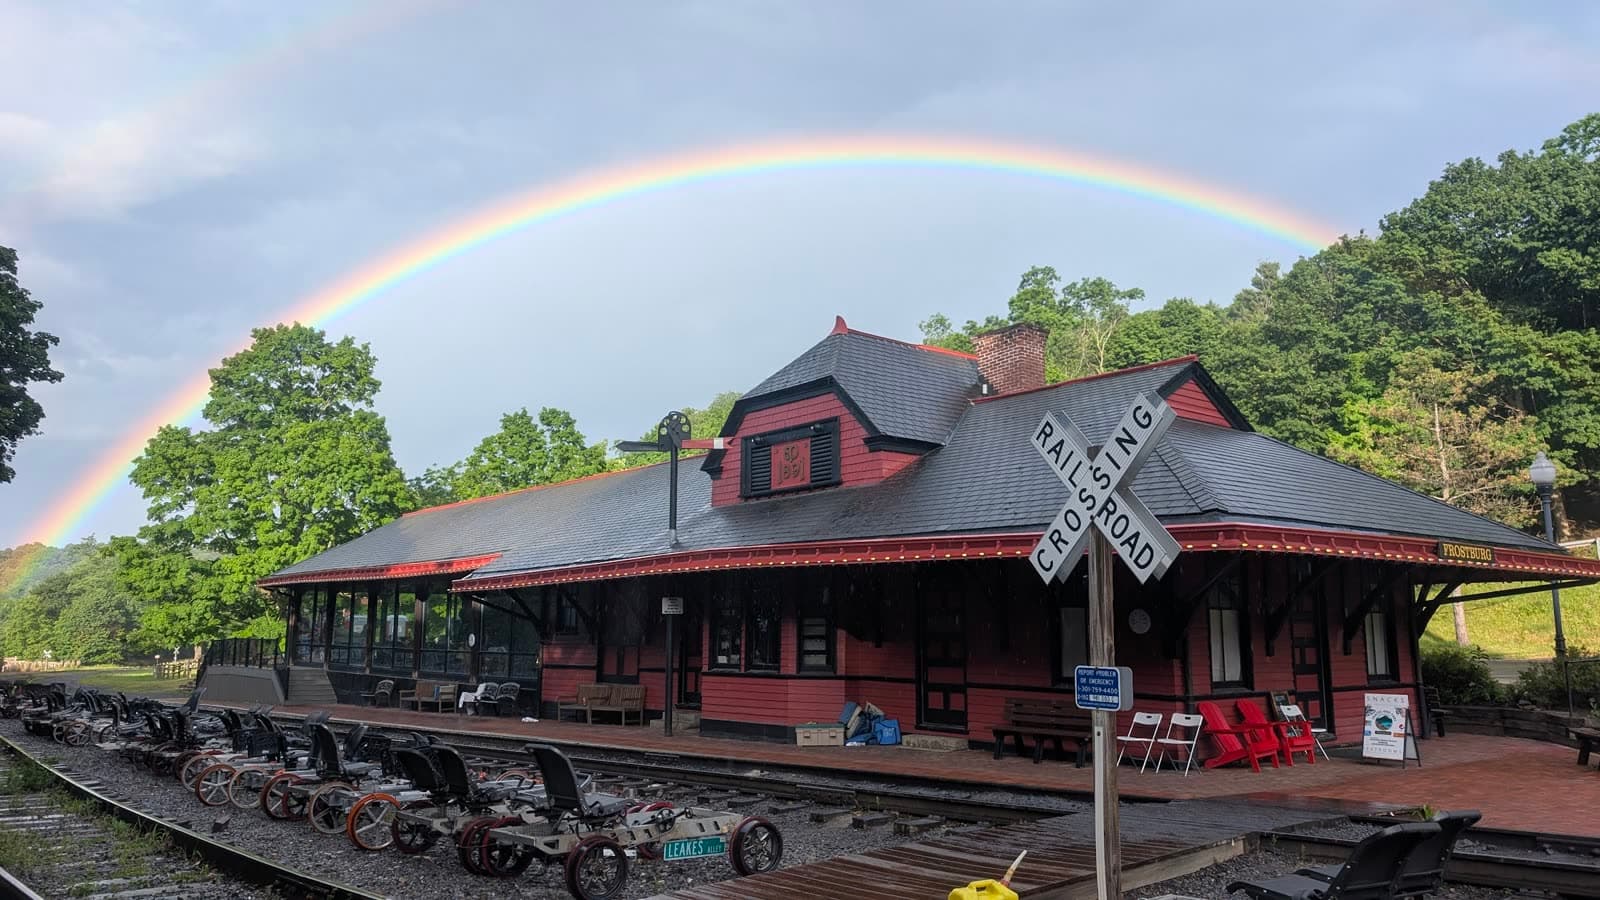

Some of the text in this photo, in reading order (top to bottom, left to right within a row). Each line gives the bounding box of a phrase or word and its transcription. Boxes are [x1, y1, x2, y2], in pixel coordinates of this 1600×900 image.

[1036, 405, 1152, 572] CROSSING
[1036, 420, 1154, 570] RAIL ROAD
[1442, 543, 1492, 561] FROSTBURG
[668, 840, 704, 857] LEAKES
